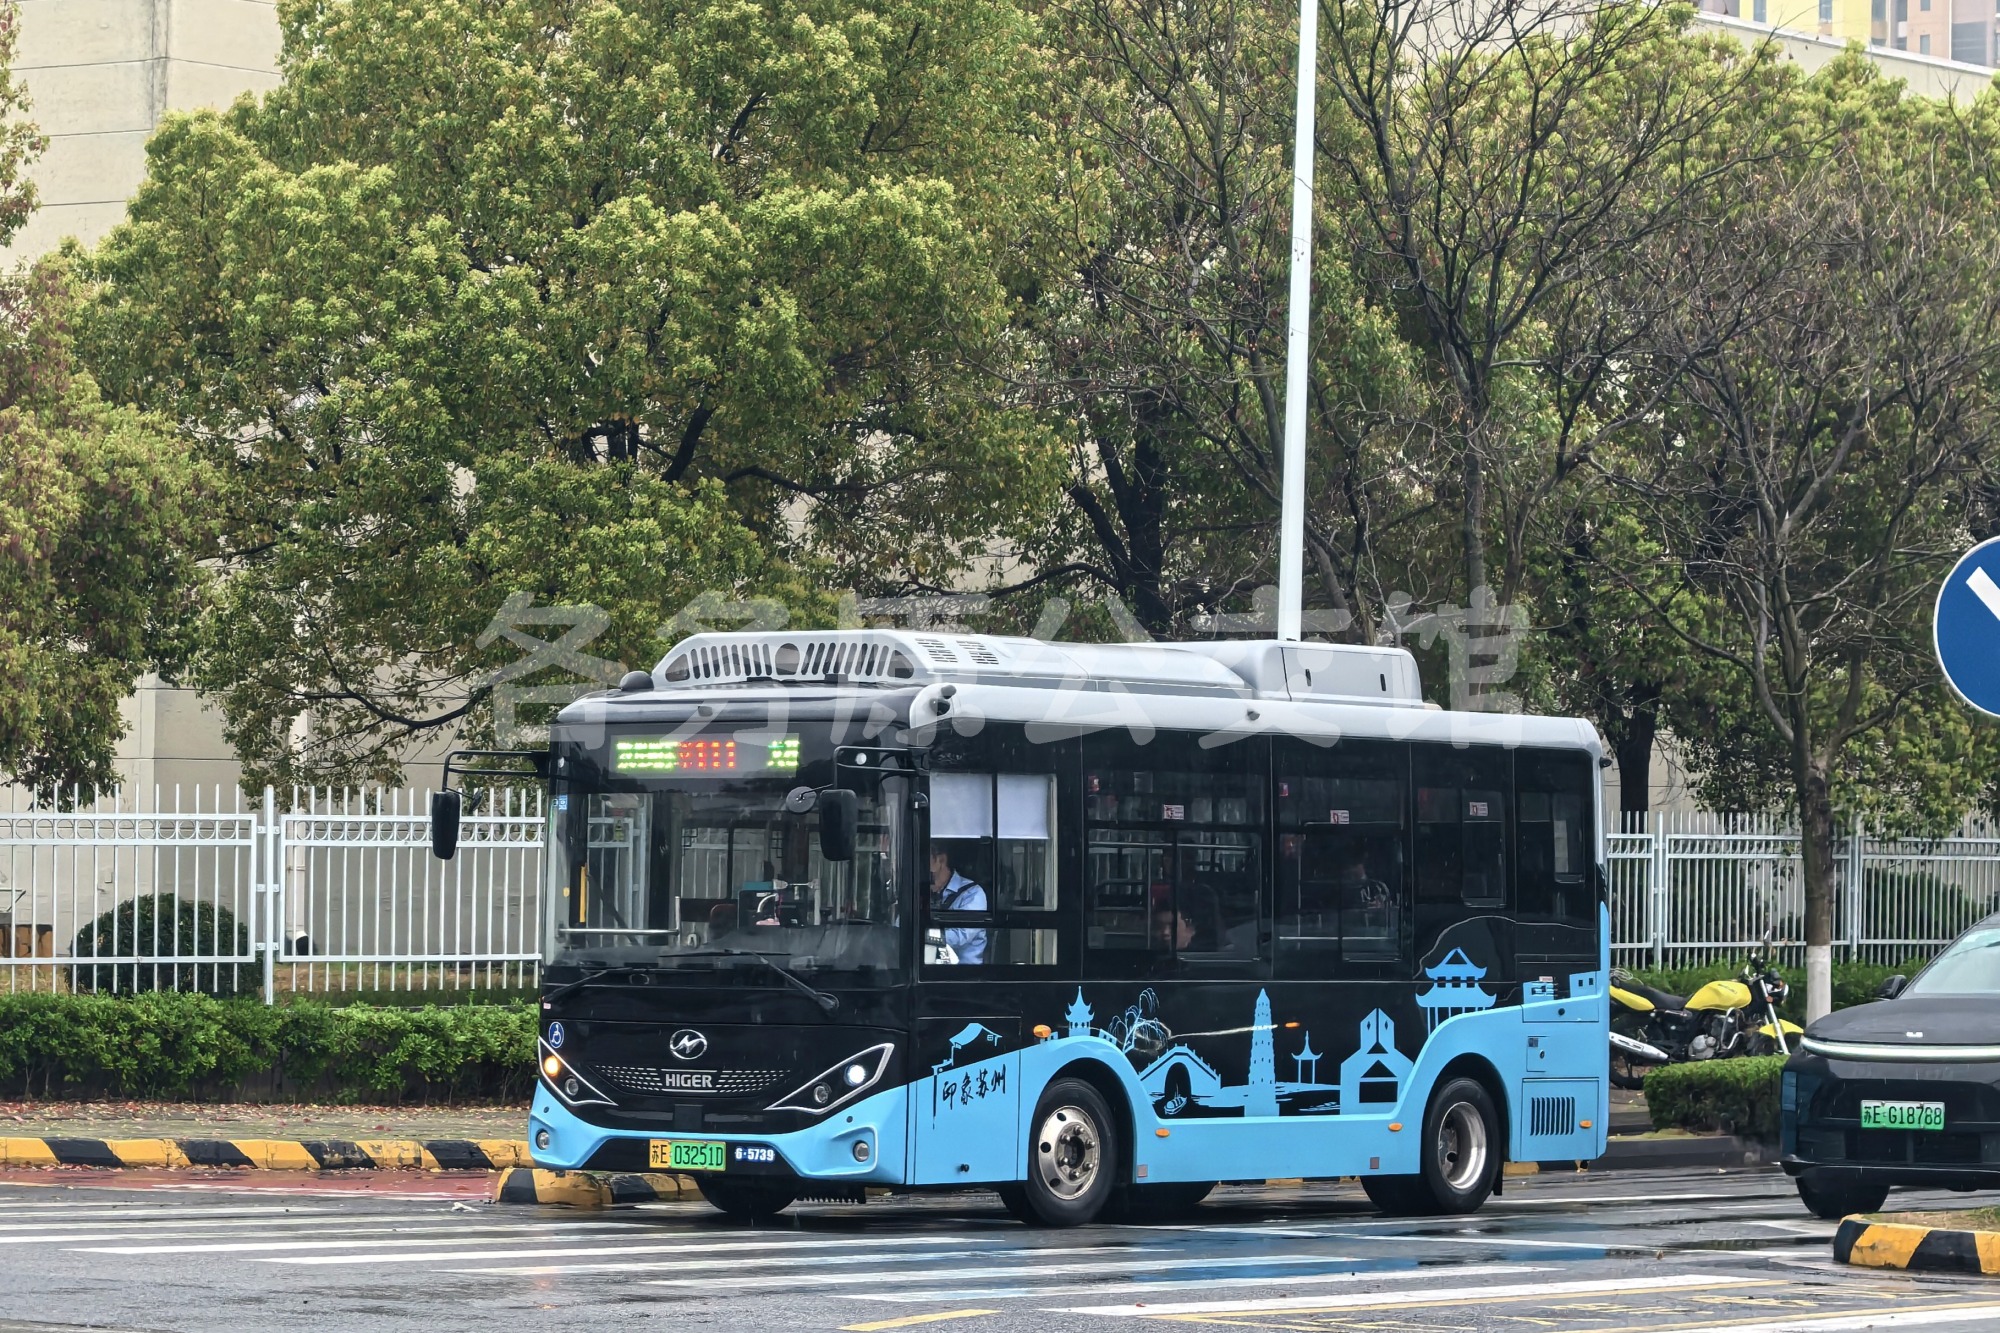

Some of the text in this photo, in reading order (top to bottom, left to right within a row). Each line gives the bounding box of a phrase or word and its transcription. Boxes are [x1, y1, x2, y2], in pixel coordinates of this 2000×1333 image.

[665, 1073, 713, 1088] HIGER
[942, 1063, 1007, 1110] 印象苏州
